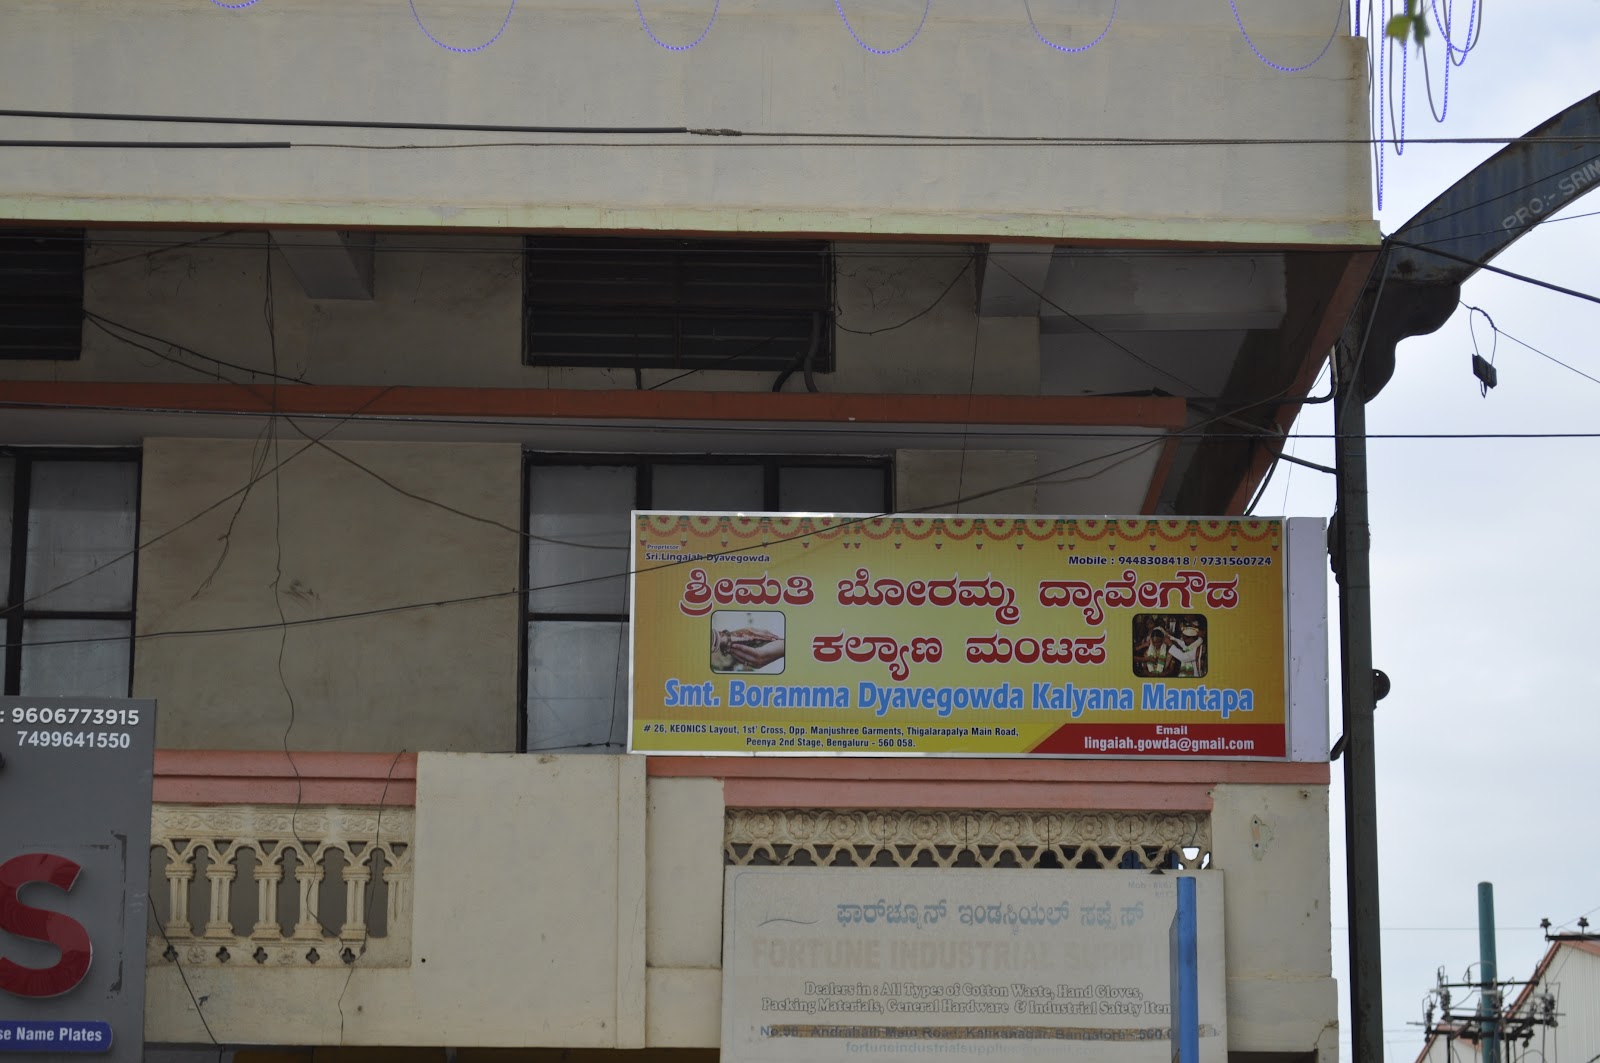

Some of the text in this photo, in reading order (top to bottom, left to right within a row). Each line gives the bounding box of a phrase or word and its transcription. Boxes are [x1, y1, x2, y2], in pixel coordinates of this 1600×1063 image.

[706, 553, 770, 564] Dyavegowda
[1068, 556, 1108, 565] Mobile
[1118, 556, 1190, 566] 9448308418
[1200, 557, 1272, 566] 9731560724
[679, 567, 1240, 626] ಶ್ರೀಮತಿ ಬೋರಮ್ಮ ದ್ಯಾವೇಗೌಡ
[812, 628, 1107, 681] ಕಲ್ಯಾಣ ಮಂಟಪ
[664, 678, 1254, 719] Smt. Boramma Dyavegowda Kalyana Mantapa
[12, 708, 139, 725] 9606773915
[643, 725, 651, 733] #
[653, 725, 667, 734] 26,
[670, 725, 707, 734] KEONICS
[709, 725, 740, 736] Layout,
[760, 726, 786, 736] Cross,
[789, 727, 808, 737] Opp.
[810, 726, 859, 737] Manjushree
[861, 727, 904, 737] Garments,
[907, 727, 967, 739] Thigalarapalya
[971, 727, 992, 736] Main
[995, 727, 1019, 738] Road,
[1156, 725, 1188, 736] Email
[17, 731, 130, 748] 7499641550
[746, 738, 777, 748] Peenya
[779, 738, 795, 747] 2nd
[797, 738, 824, 749] Stage,
[826, 738, 869, 749] Bengaluru
[878, 738, 894, 747] 560
[896, 738, 916, 747] 058.
[1084, 736, 1254, 751] lingaiah.gowda@gmail.com
[805, 981, 854, 996] Dealers
[856, 982, 871, 995] in
[880, 982, 901, 996] All
[904, 983, 944, 999] Types
[946, 983, 961, 996] of
[962, 983, 1008, 997] Cotton
[1011, 984, 1055, 999] Waste,
[1057, 985, 1093, 998] Hand
[1095, 984, 1144, 1000] Gloves,
[762, 997, 816, 1014] Packing
[818, 999, 884, 1014] Materials,
[886, 1000, 939, 1013] General
[941, 1000, 1009, 1014] Hardware
[1014, 1001, 1028, 1014] &
[1029, 1000, 1097, 1015] Industrial
[1099, 1001, 1142, 1017] Safety
[16, 1027, 55, 1041] Name
[59, 1027, 103, 1041] Plates
